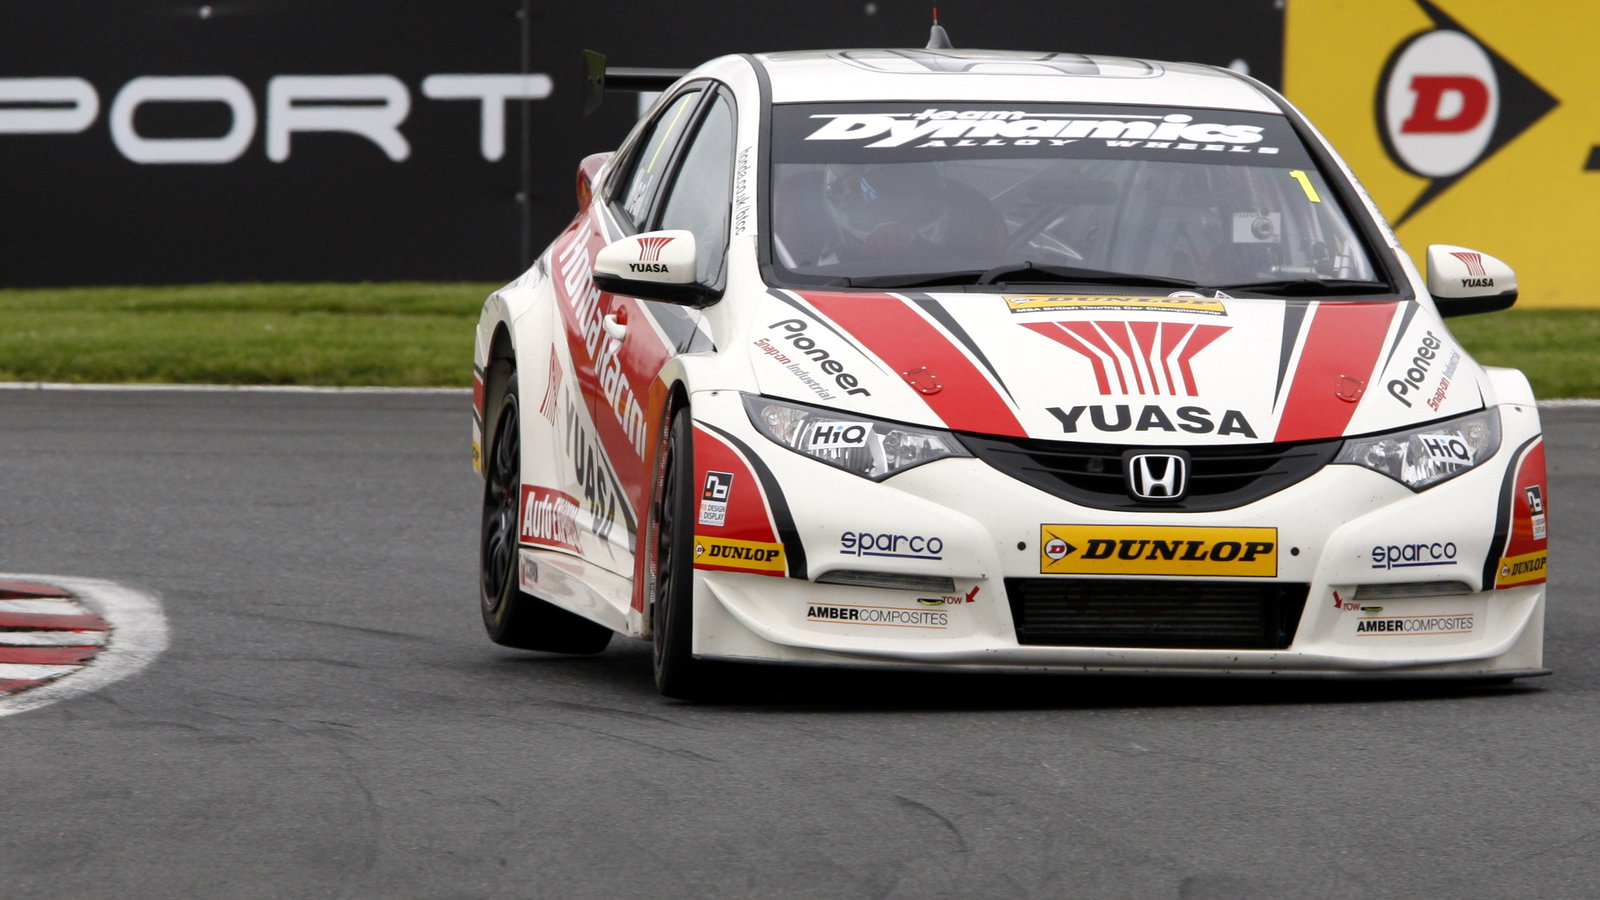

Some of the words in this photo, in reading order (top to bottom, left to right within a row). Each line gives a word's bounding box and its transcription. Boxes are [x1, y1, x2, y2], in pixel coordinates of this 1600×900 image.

[914, 109, 1026, 120] team
[804, 113, 1265, 147] Dynamics
[914, 140, 1079, 148] ALLOY
[1106, 140, 1279, 154] WHEELS
[1289, 170, 1321, 203] 1
[629, 263, 669, 273] YUASA
[1461, 278, 1494, 287] YUASA
[768, 318, 871, 397] Pioneer
[1387, 330, 1441, 409] Pioneer
[1045, 405, 1258, 439] YUASA
[812, 425, 866, 445] HiQ
[1424, 437, 1470, 462] HiQ
[709, 545, 780, 562] DUNLOP
[840, 531, 943, 557] sparco
[1080, 539, 1274, 562] DUNLOP
[1372, 541, 1457, 569] sparco
[1512, 557, 1547, 577] DUNLOP
